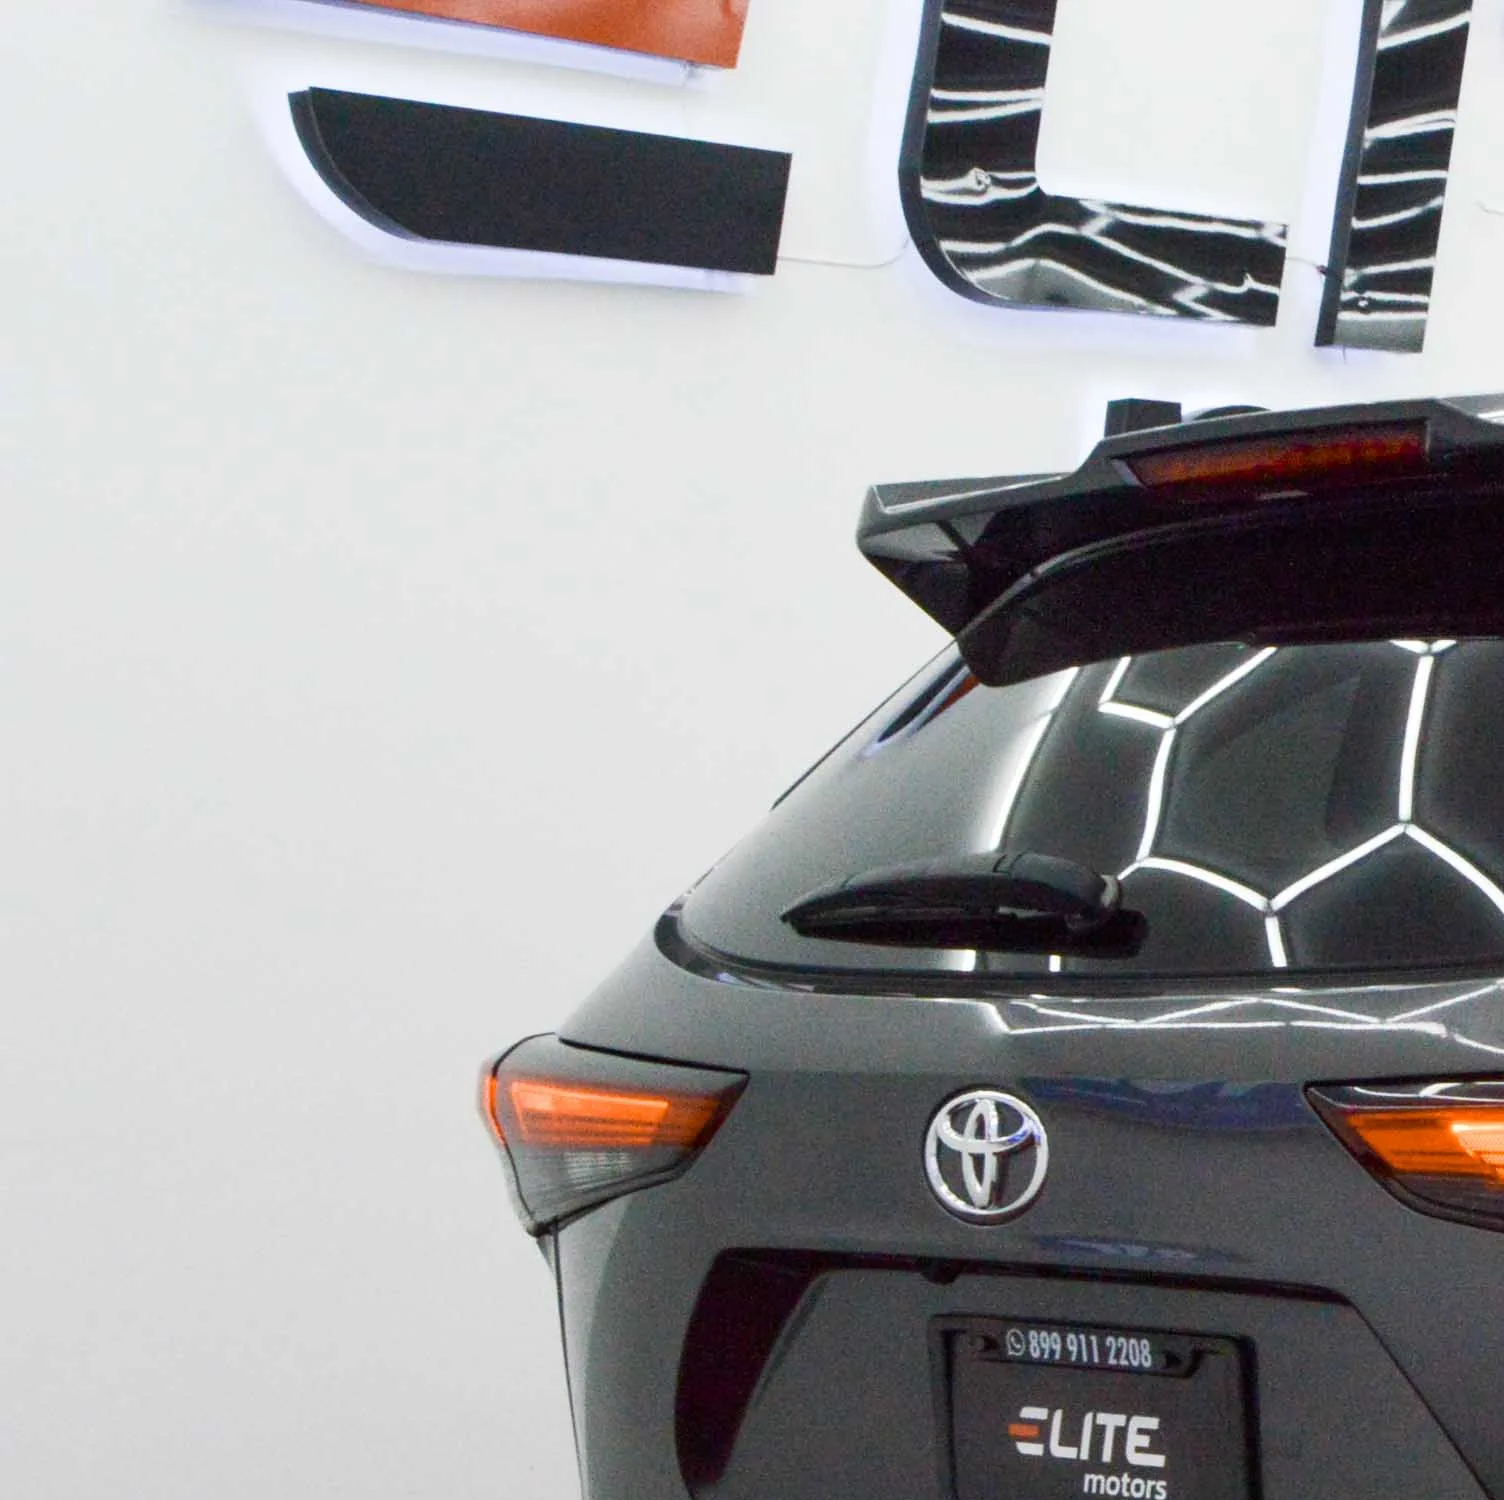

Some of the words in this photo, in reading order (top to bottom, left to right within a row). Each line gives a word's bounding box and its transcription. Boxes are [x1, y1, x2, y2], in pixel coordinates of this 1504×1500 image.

[1028, 1330, 1062, 1361] 899
[1067, 1333, 1100, 1363] 911
[1106, 1336, 1152, 1368] 2208
[1008, 1406, 1166, 1468] ELITE
[1083, 1472, 1168, 1500] motors
